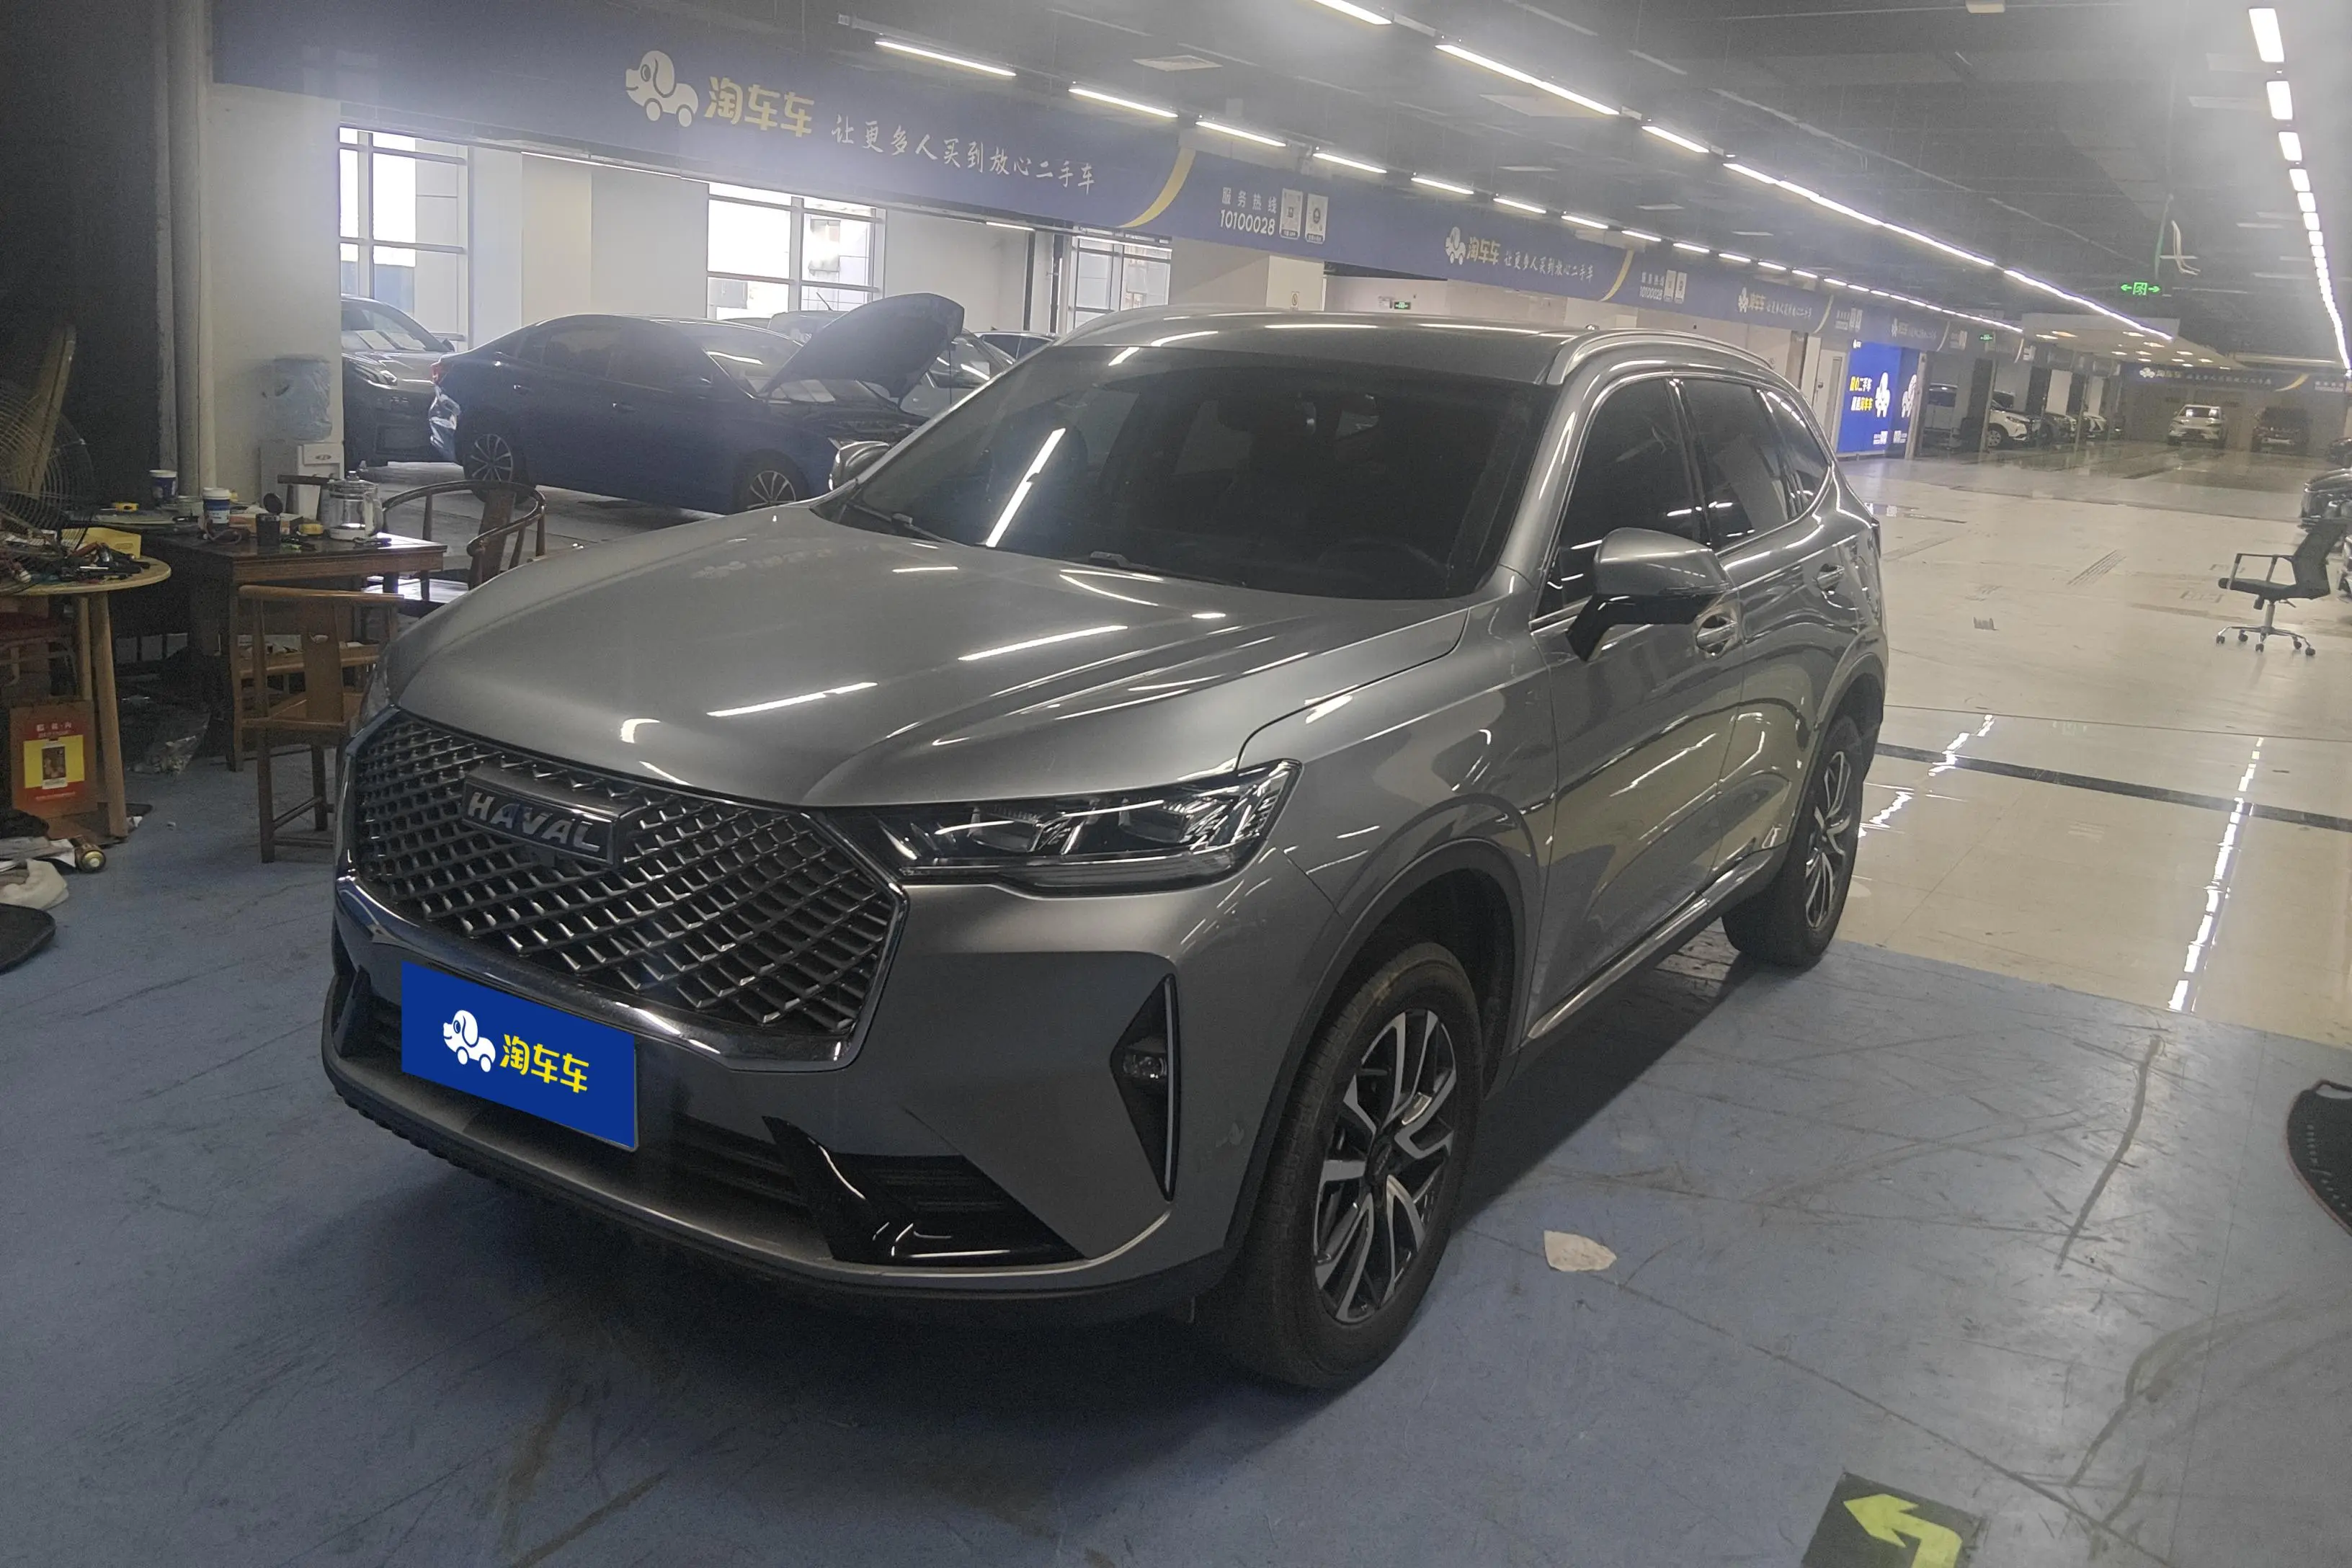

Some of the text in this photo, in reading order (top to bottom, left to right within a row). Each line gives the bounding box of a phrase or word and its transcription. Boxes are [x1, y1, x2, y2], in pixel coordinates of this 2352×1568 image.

[704, 76, 1095, 195] 淘车车 让更多人买到放心二手车
[1221, 187, 1278, 214] 服务热线
[1219, 209, 1276, 236] 10100028
[1467, 236, 1501, 265] 淘车车
[468, 792, 600, 852] HAVAL
